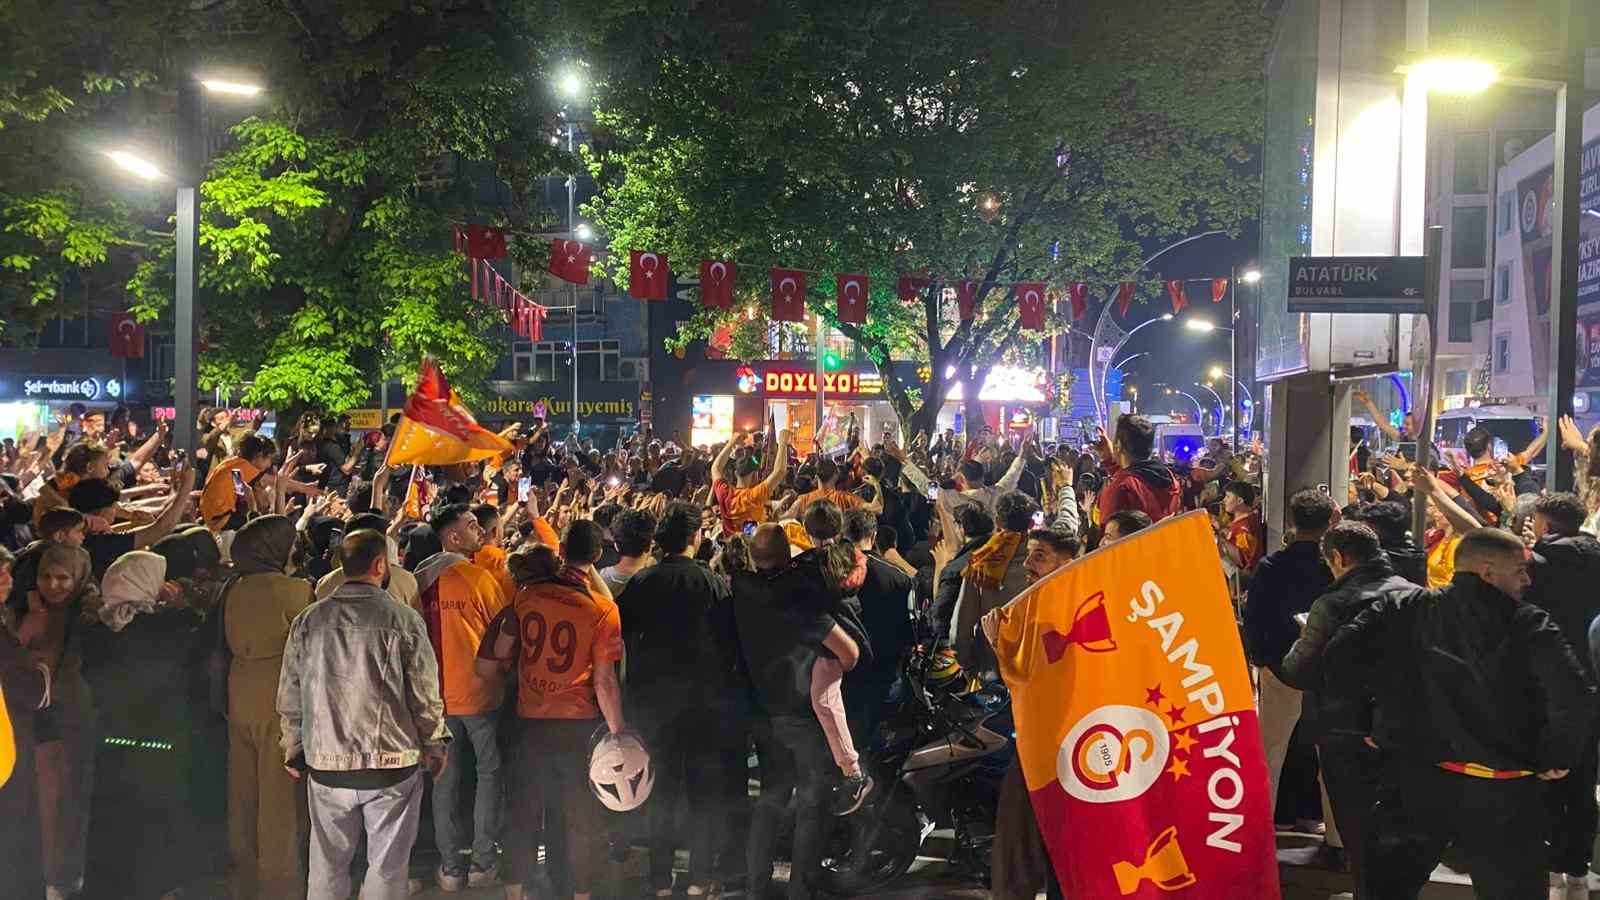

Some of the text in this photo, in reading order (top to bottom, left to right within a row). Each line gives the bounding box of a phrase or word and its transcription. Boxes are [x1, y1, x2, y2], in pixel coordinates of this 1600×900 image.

[1296, 264, 1379, 281] ATATÜRK
[487, 396, 535, 415] nkara
[522, 611, 577, 673] 99
[1126, 580, 1245, 853] ŞAMPİYON
[1099, 743, 1113, 767] 1905
